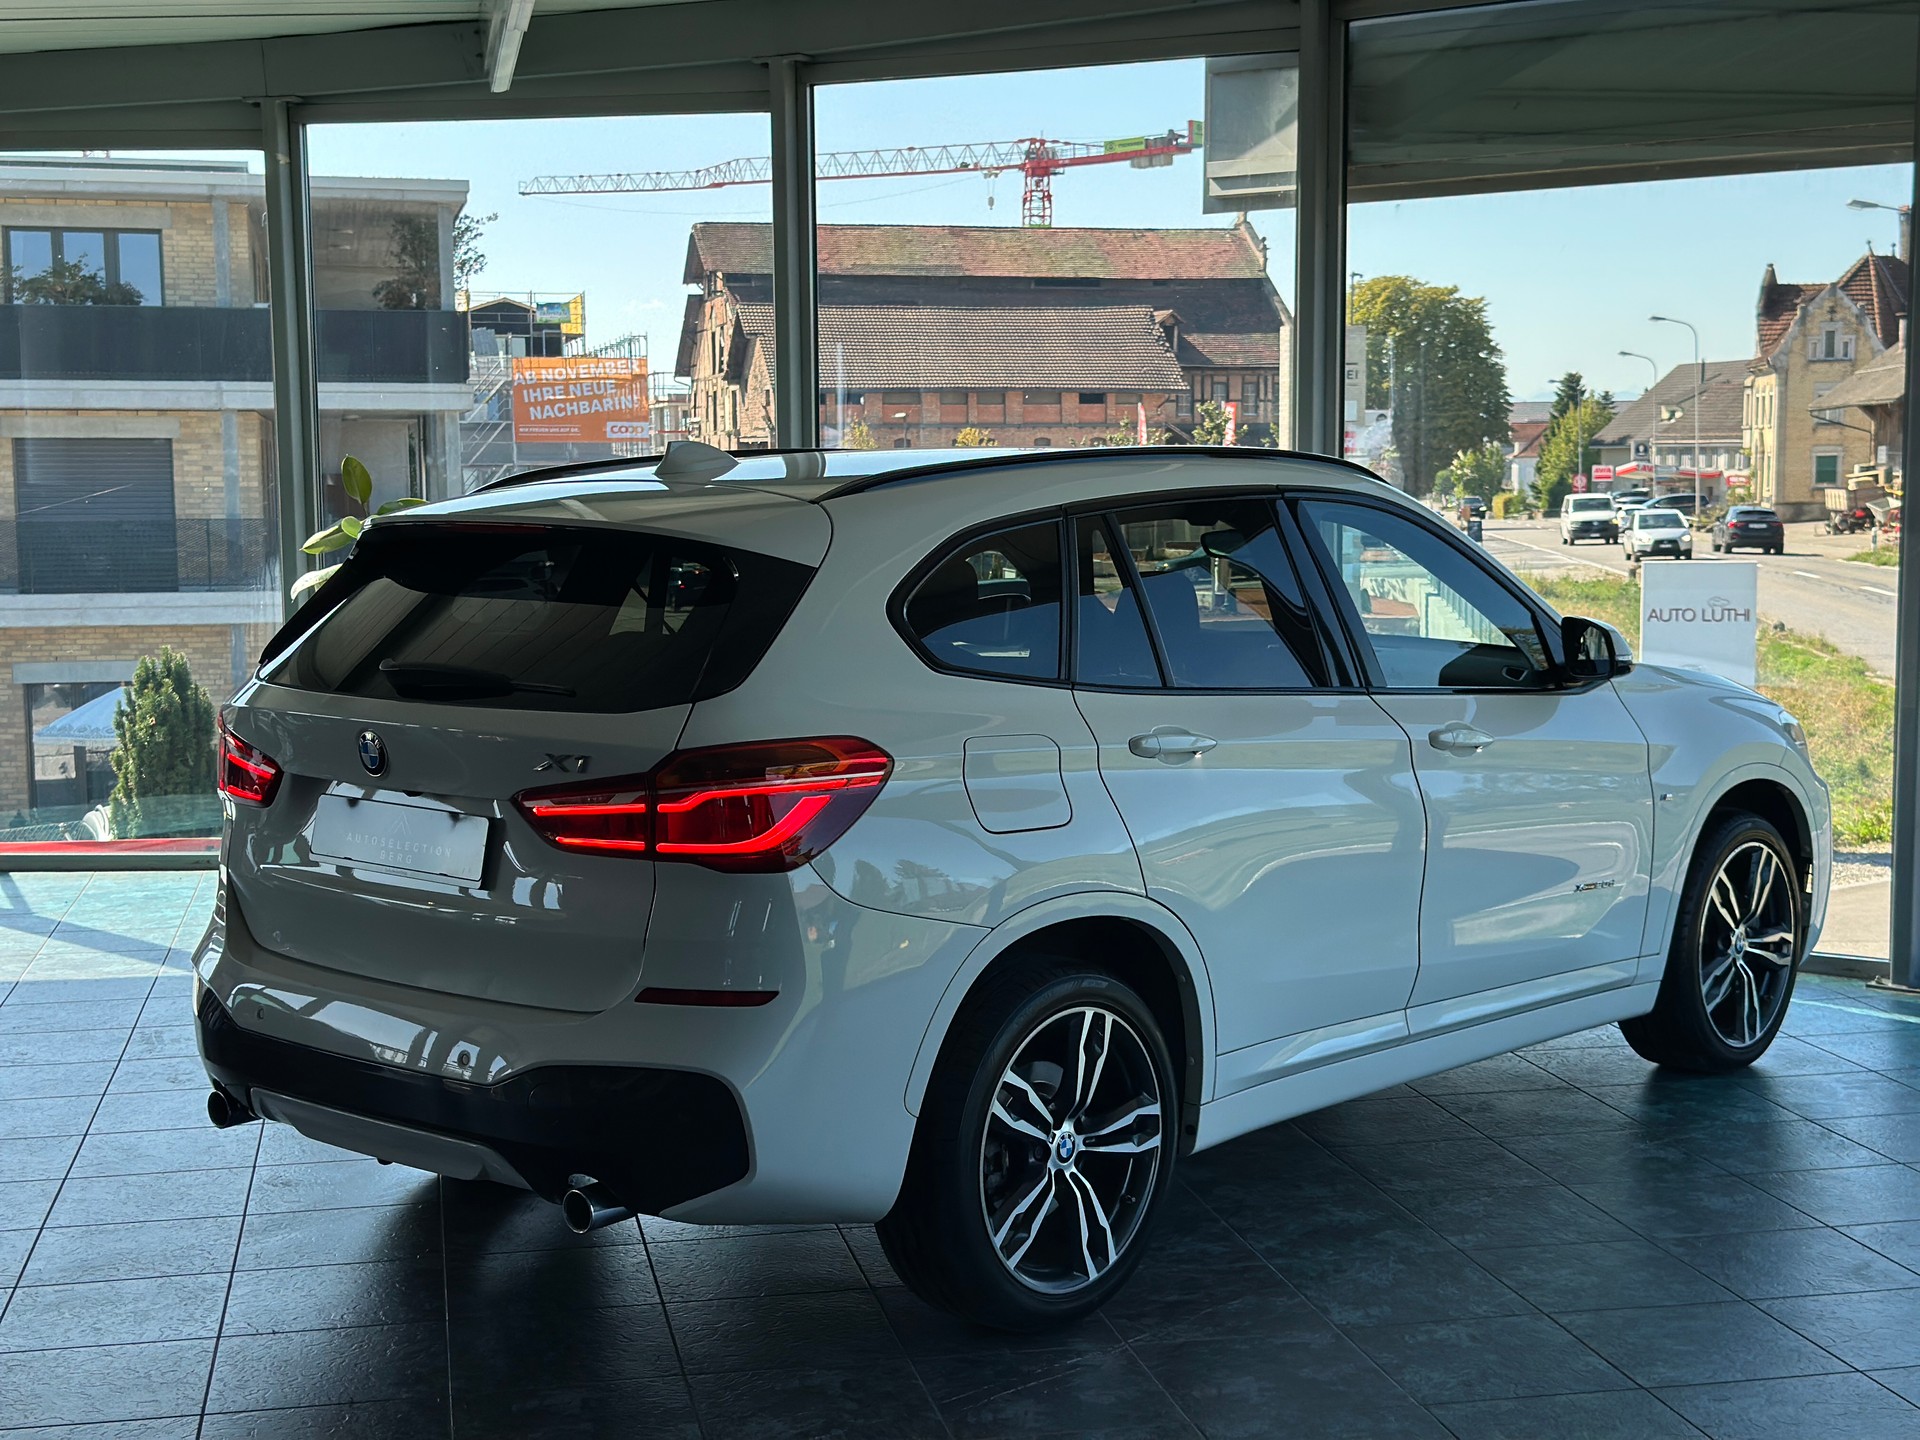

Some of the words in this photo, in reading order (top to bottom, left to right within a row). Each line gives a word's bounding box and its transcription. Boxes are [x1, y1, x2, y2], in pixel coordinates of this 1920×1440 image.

[514, 371, 538, 386] AB
[541, 360, 640, 382] NOVEMBER
[523, 386, 565, 403] IHRE
[569, 379, 617, 398] NEUE
[1647, 608, 1697, 622] AUTO
[533, 752, 592, 775] X1
[346, 832, 452, 858] AUTOSELECTION
[380, 849, 413, 865] BERG
